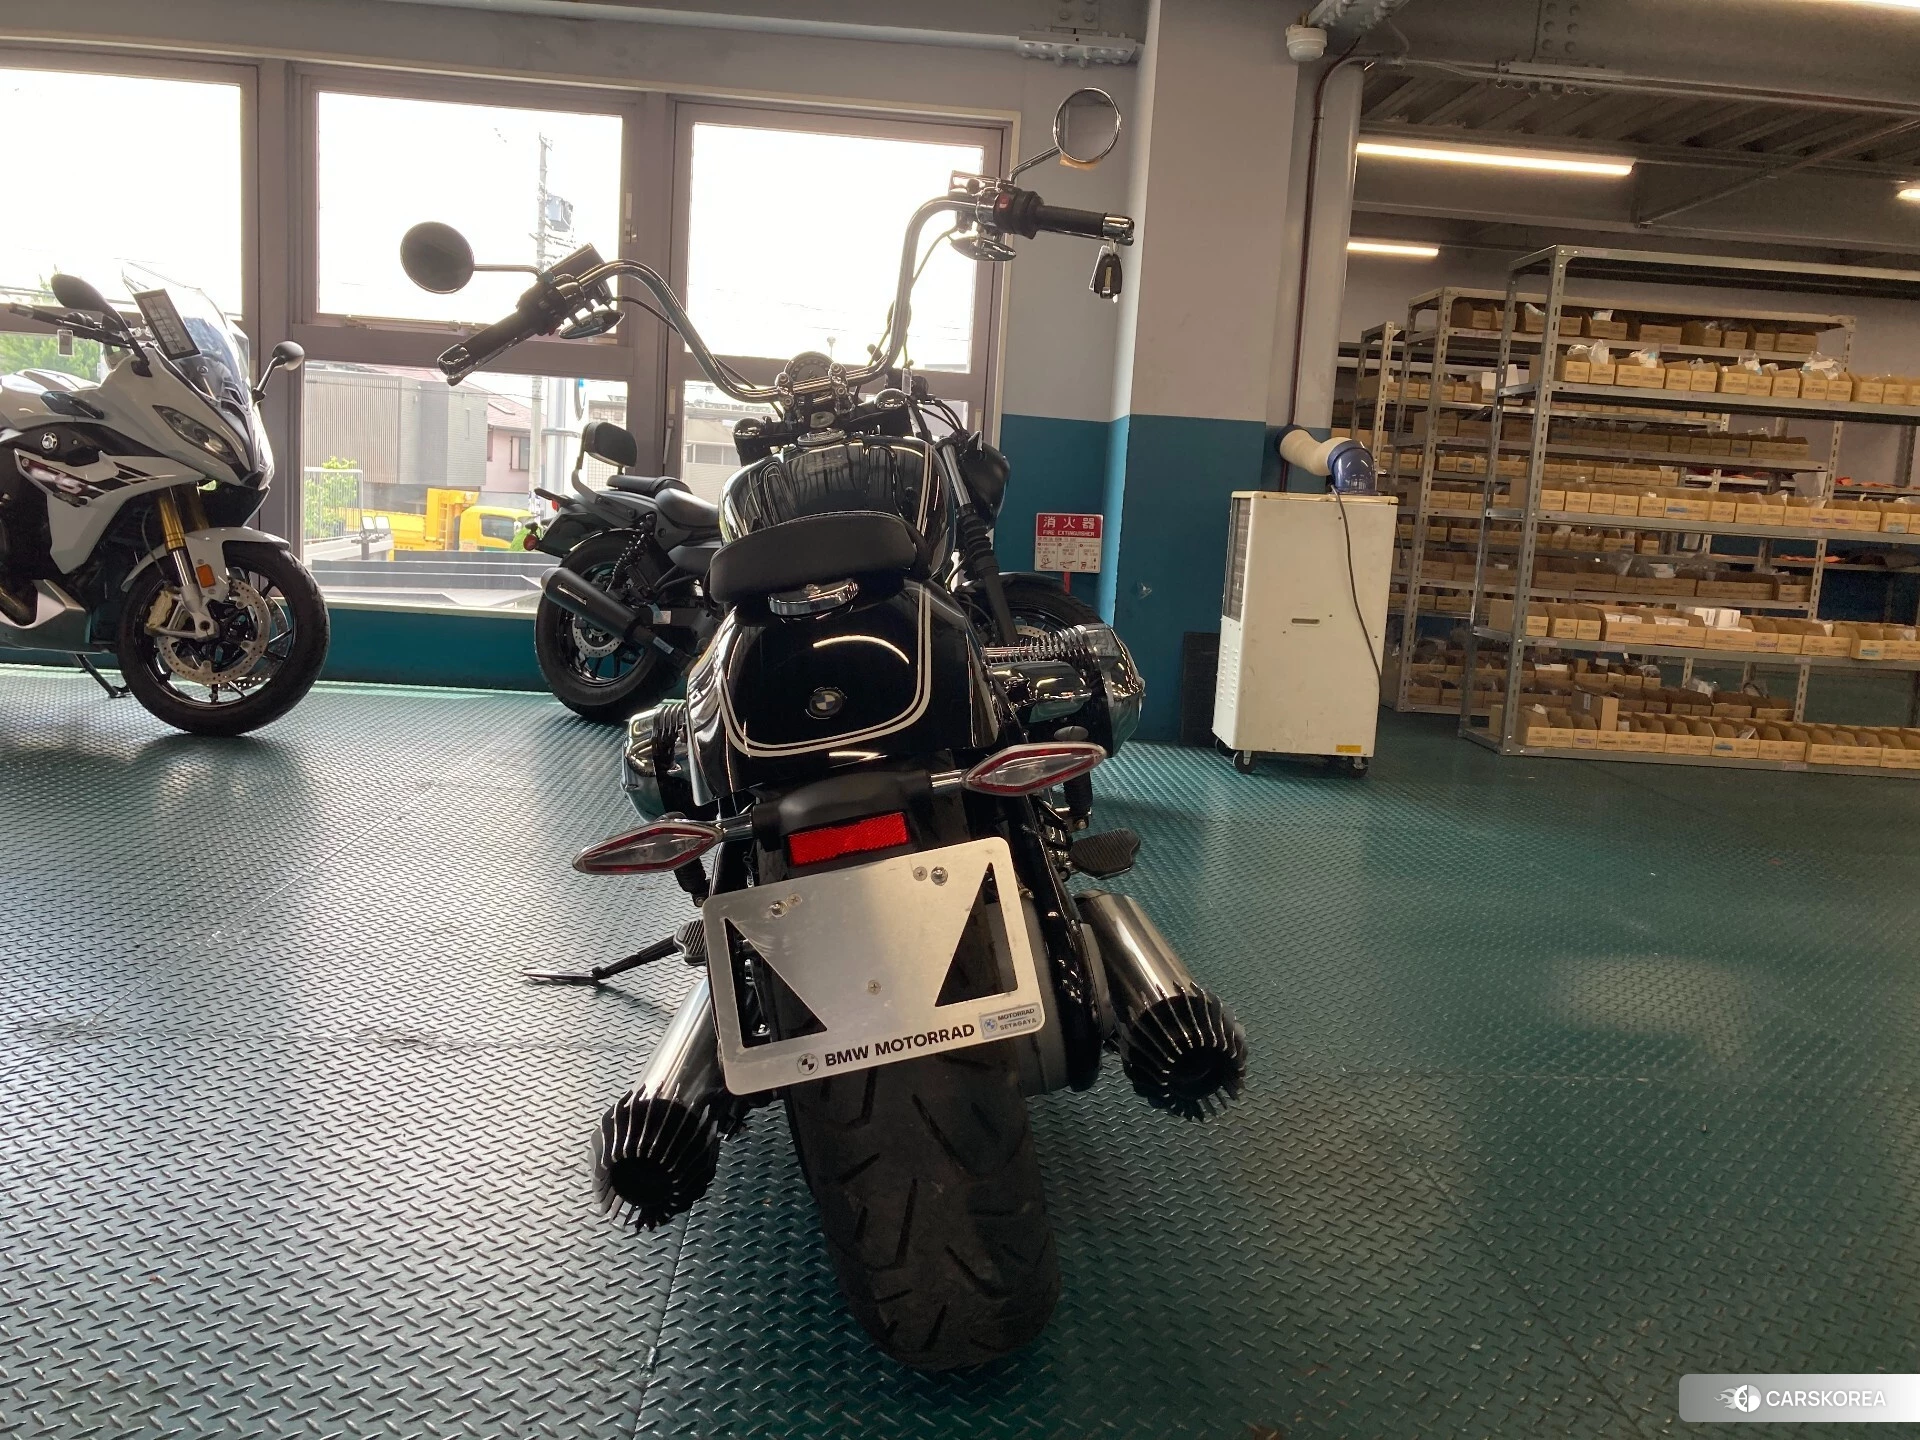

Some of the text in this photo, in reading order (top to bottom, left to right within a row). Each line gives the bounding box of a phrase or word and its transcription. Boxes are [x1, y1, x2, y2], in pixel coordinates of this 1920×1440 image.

[1043, 516, 1095, 529] 消火器
[997, 1008, 1035, 1021] MOTORRAD
[999, 1018, 1037, 1030] SETAGAYA
[825, 1024, 975, 1067] BMW MOTORRAD
